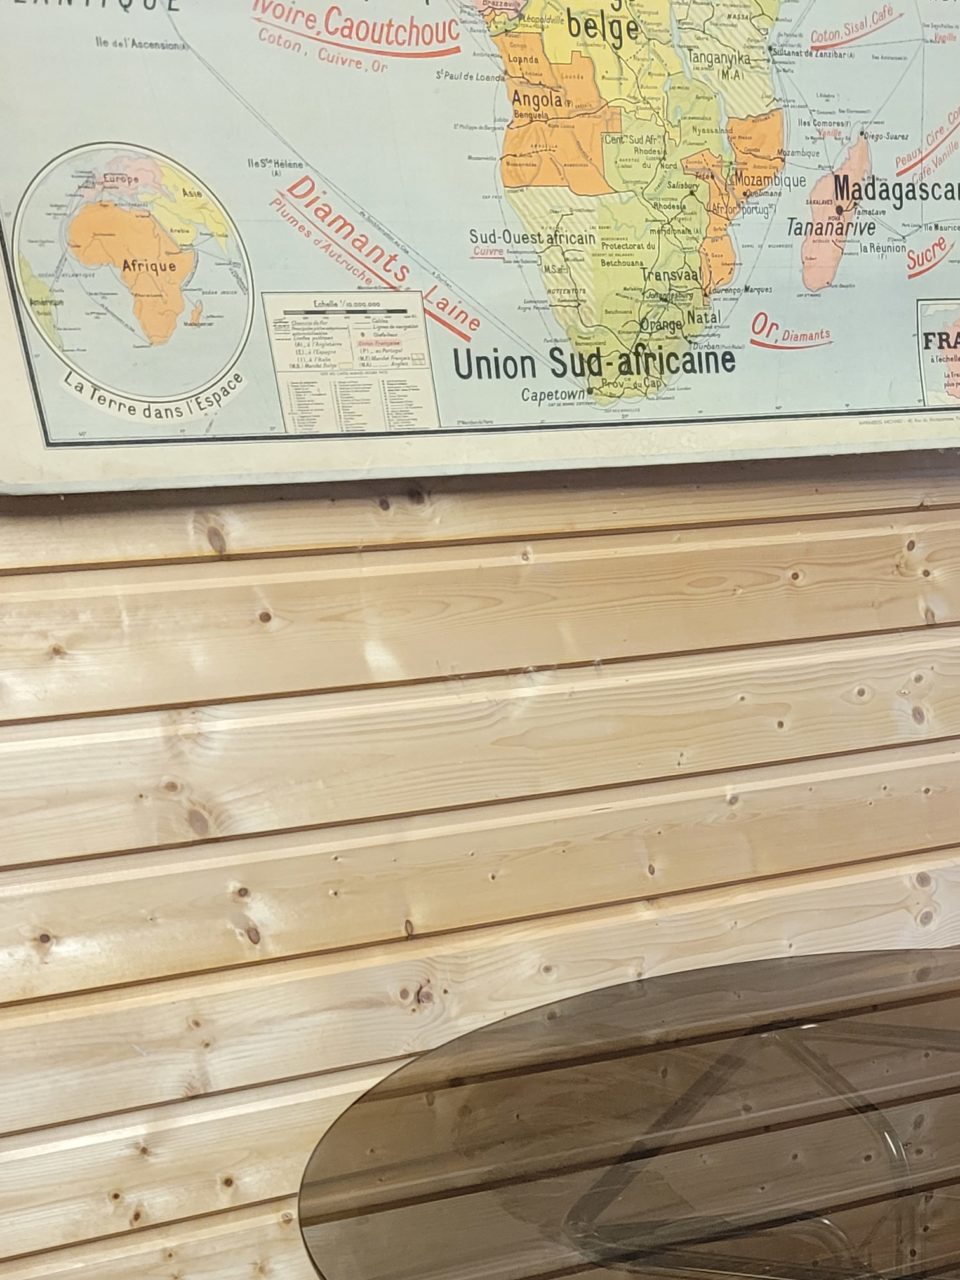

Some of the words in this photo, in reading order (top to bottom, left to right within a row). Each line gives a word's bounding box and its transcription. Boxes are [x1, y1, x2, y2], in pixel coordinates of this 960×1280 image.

[324, 6, 460, 46] Caoutchouc
[567, 7, 638, 50] belge
[372, 60, 388, 74] Or
[689, 50, 750, 69] Tanganyika
[512, 89, 563, 111] Angola
[514, 110, 549, 121] Benguela
[777, 149, 820, 158] Mozambique
[248, 159, 259, 168] Ile
[103, 174, 139, 186] Europe
[667, 181, 700, 191] Salisbury
[735, 173, 806, 192] Mozambique
[182, 188, 202, 198] Asie
[787, 217, 876, 236] Tananarive
[269, 198, 312, 238] Plumes
[314, 238, 373, 285] d'Autruche
[469, 229, 543, 244] Sud-Ouest
[547, 229, 596, 245] africain
[287, 175, 410, 282] Diamants
[423, 285, 480, 332] Laine
[474, 246, 504, 256] Cuivre
[869, 243, 906, 253] Réunion
[907, 236, 947, 271] Sucre
[122, 259, 176, 276] Afrique
[641, 267, 701, 281] Transvaal
[688, 310, 721, 324] Natal
[641, 319, 682, 335] Orange
[782, 328, 831, 343] Diamants
[453, 348, 536, 380] Union
[550, 343, 736, 379] Sud-africaine
[644, 378, 661, 391] Cap
[64, 371, 83, 394] La
[89, 384, 137, 416] Terre
[143, 403, 184, 419] dans
[186, 372, 243, 415] l'Espace
[521, 388, 585, 407] Capetown
